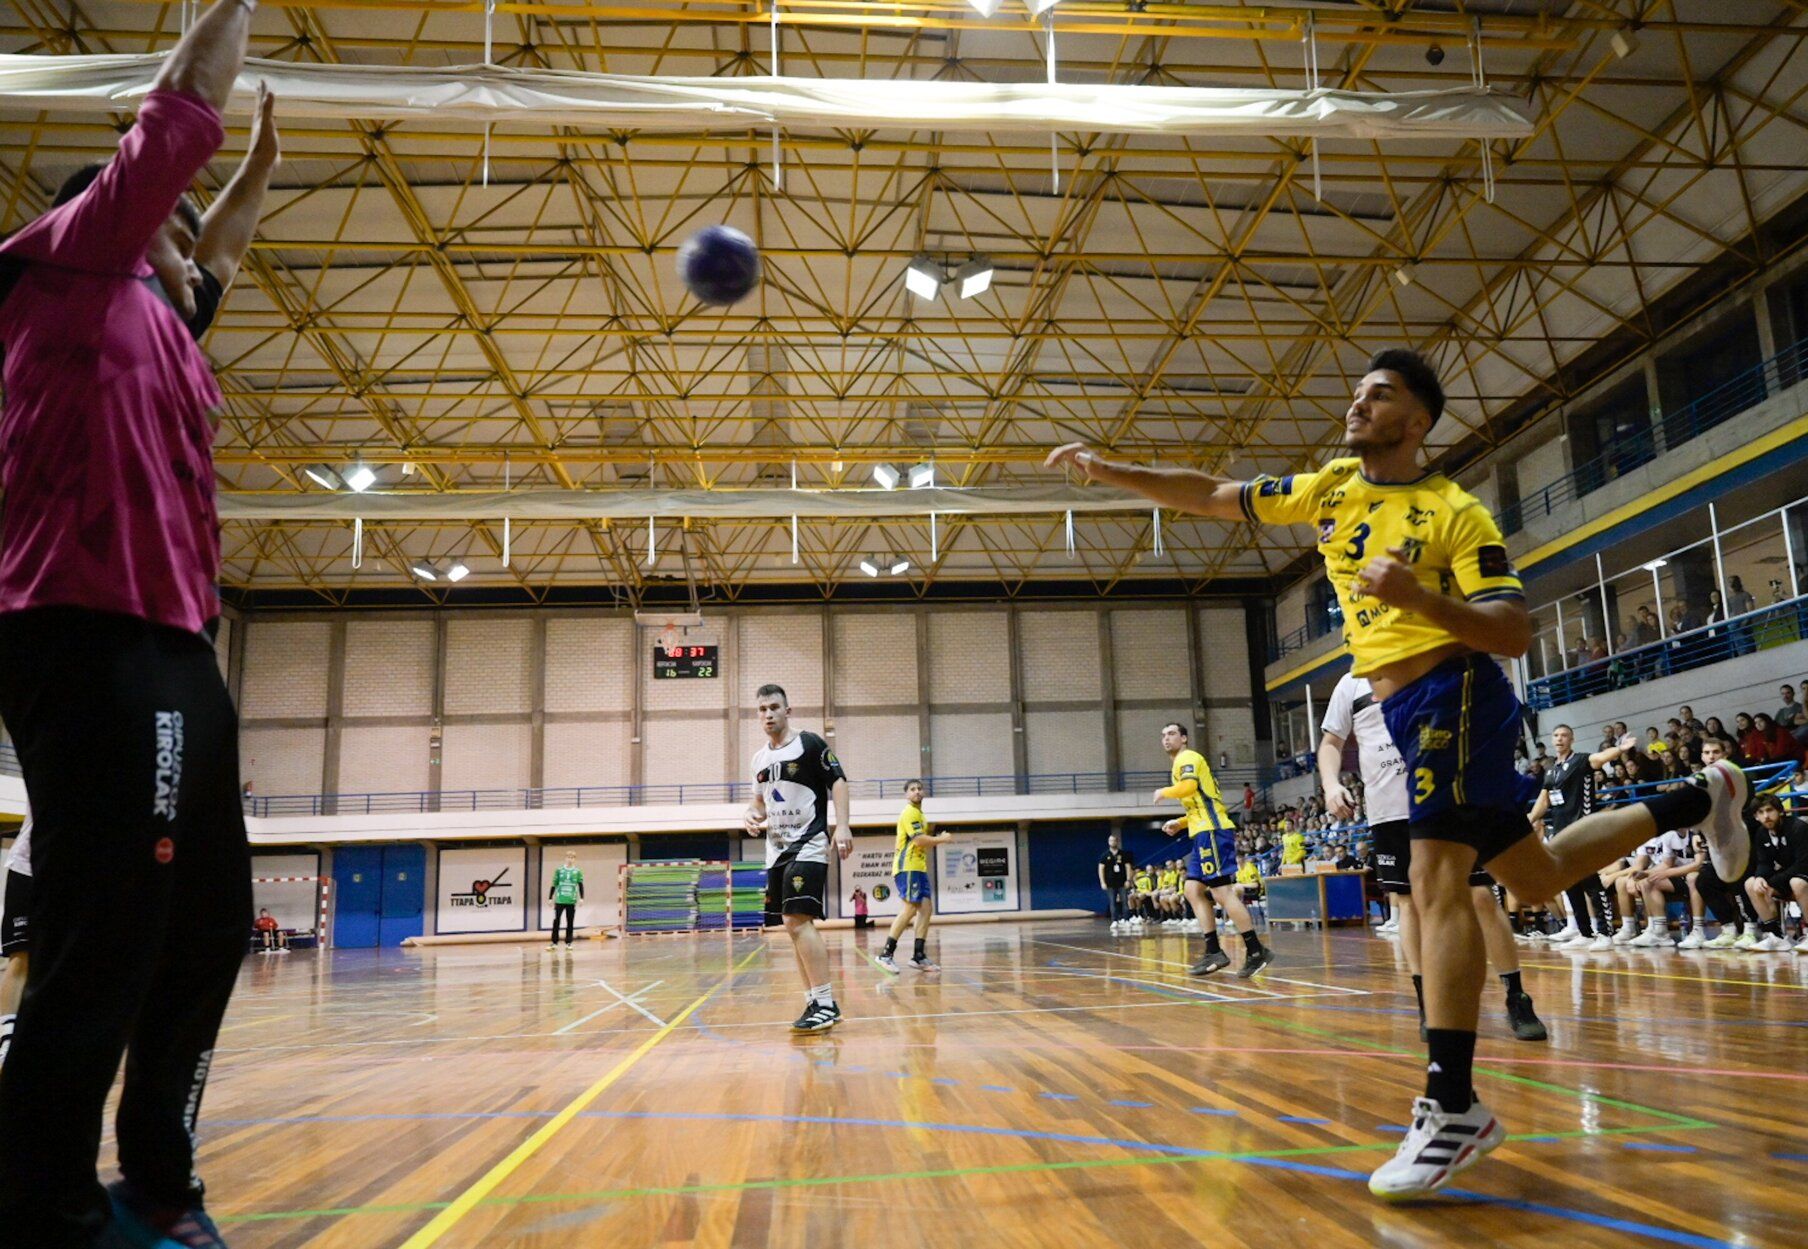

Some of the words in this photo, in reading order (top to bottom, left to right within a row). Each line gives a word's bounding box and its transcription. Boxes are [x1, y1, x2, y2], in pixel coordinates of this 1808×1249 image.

[1344, 522, 1371, 560] 3
[698, 667, 713, 677] 22
[154, 711, 173, 816] KIROLAK
[1414, 767, 1436, 804] 3
[1200, 861, 1215, 875] 10
